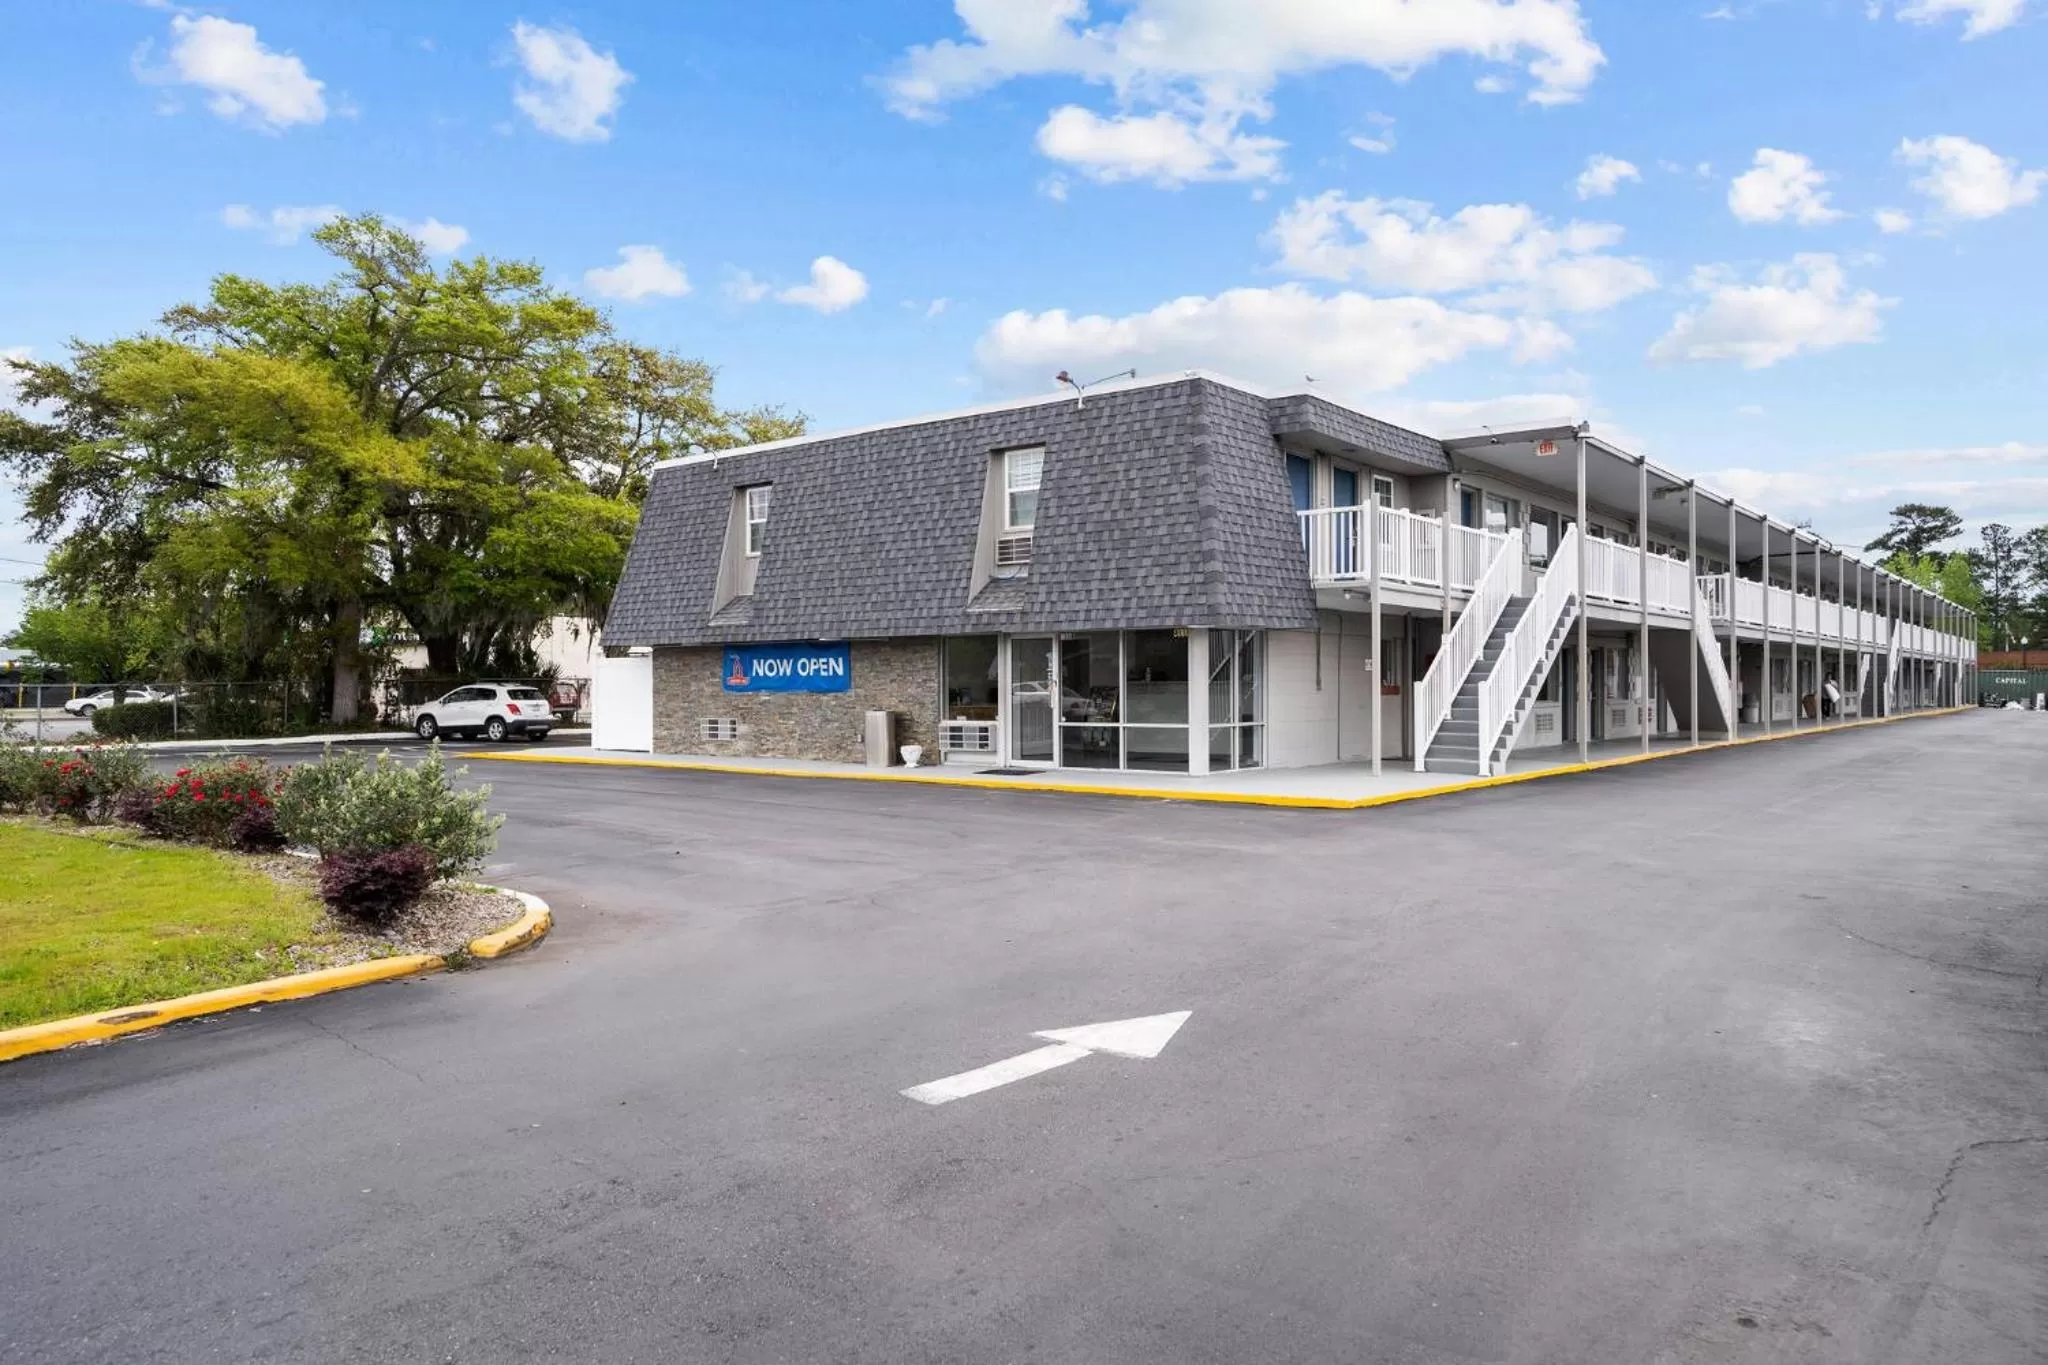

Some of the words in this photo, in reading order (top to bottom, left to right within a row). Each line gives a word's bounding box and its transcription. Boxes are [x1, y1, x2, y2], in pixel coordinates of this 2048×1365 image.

[752, 658, 793, 677] NOW
[797, 657, 844, 676] OPEN
[1995, 676, 2026, 685] CAPITAL
